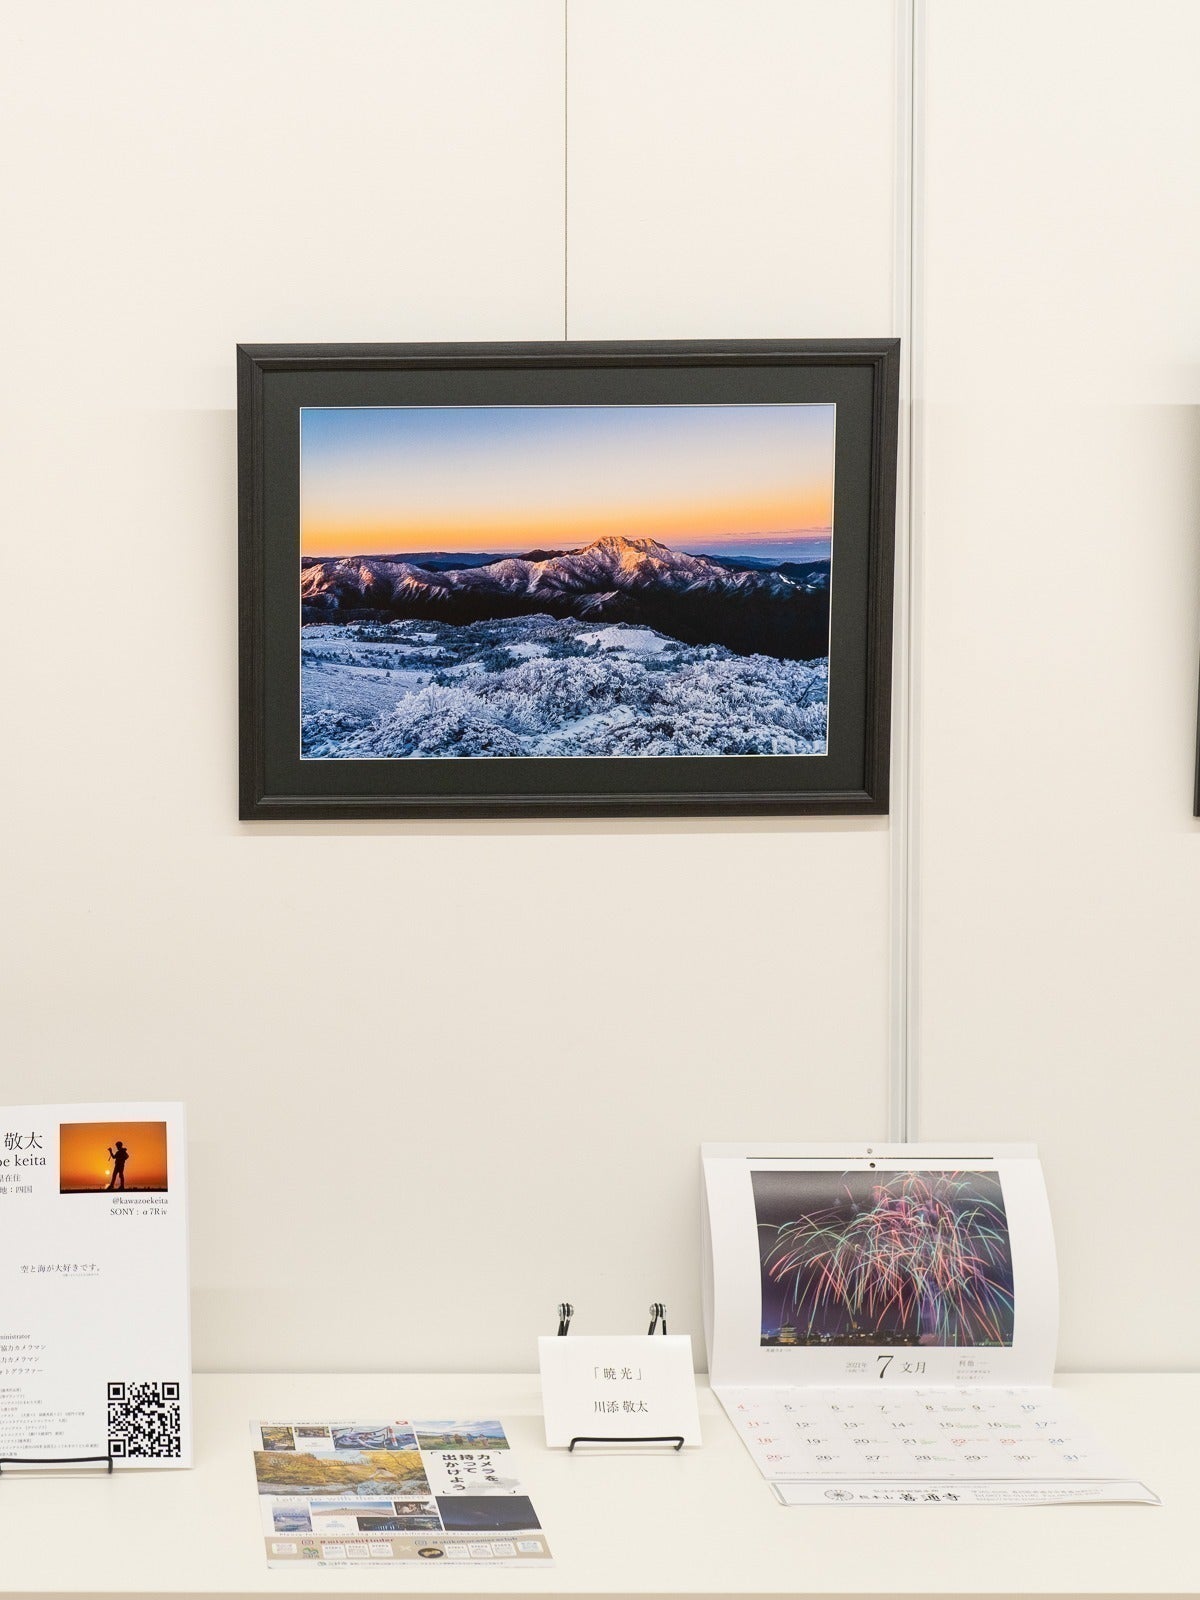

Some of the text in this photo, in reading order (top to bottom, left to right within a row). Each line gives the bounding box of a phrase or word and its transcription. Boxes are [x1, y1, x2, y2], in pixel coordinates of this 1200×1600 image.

[3, 1131, 43, 1151] 敬太
[14, 1154, 47, 1168] keita
[112, 1196, 168, 1205] @kawazoekeita
[19, 1263, 101, 1274] 空と海が大好きです。
[876, 1355, 895, 1379] 7
[900, 1361, 926, 1374] 文月
[593, 1400, 649, 1414] 川添 敬太
[441, 1454, 466, 1491] 出かけよう
[460, 1454, 477, 1474] 持って
[476, 1454, 499, 1482] カメラを
